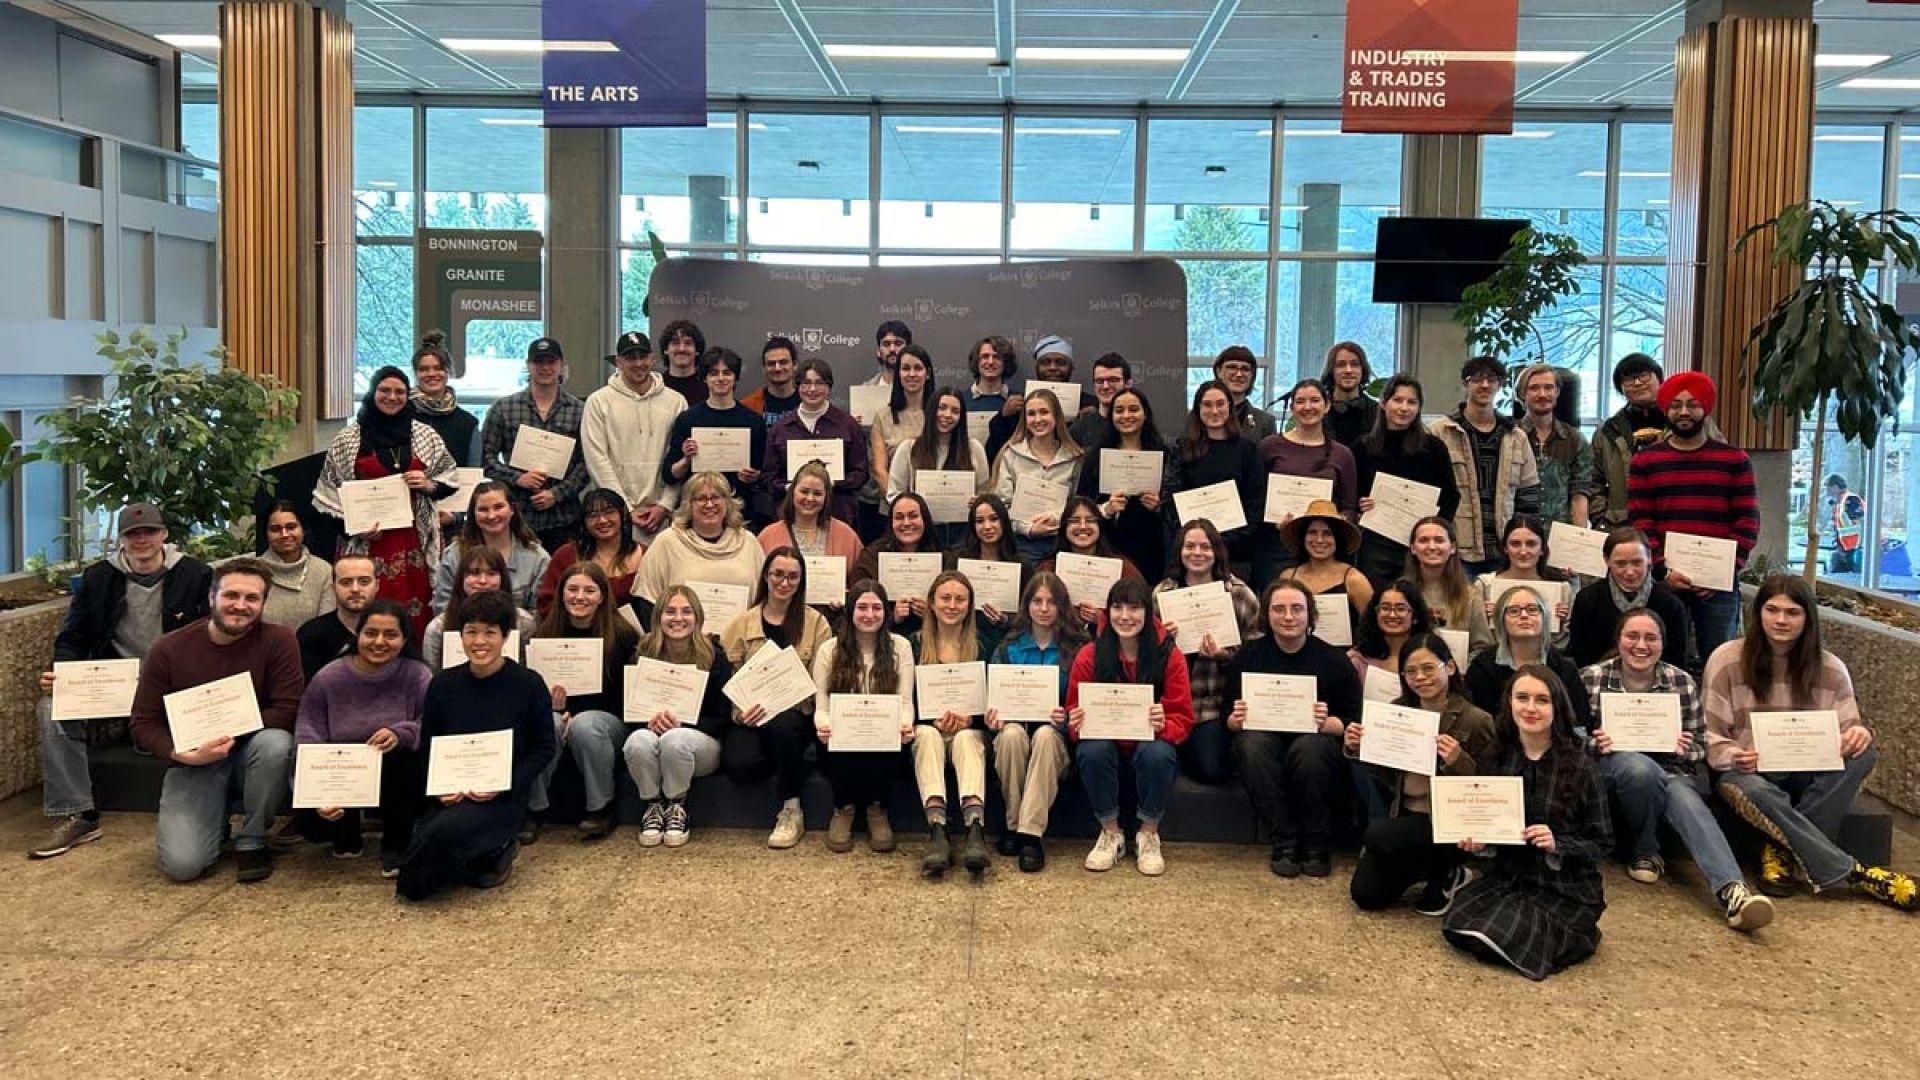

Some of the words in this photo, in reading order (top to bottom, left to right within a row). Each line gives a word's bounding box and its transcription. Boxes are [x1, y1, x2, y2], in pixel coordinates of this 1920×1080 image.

[1351, 50, 1446, 66] INDUSTRY
[1349, 70, 1363, 86] &
[1370, 71, 1446, 87] TRADES
[548, 85, 585, 102] THE
[591, 85, 639, 102] ARTS
[1348, 91, 1446, 107] TRAINING
[428, 237, 518, 251] BONNINGTON
[446, 268, 505, 281] GRANITE
[460, 299, 537, 312] MONASHEE
[880, 303, 912, 315] Selkirk
[934, 304, 971, 317] College
[1089, 297, 1121, 309] Selkirk
[1142, 296, 1182, 310] College
[823, 332, 860, 347] College
